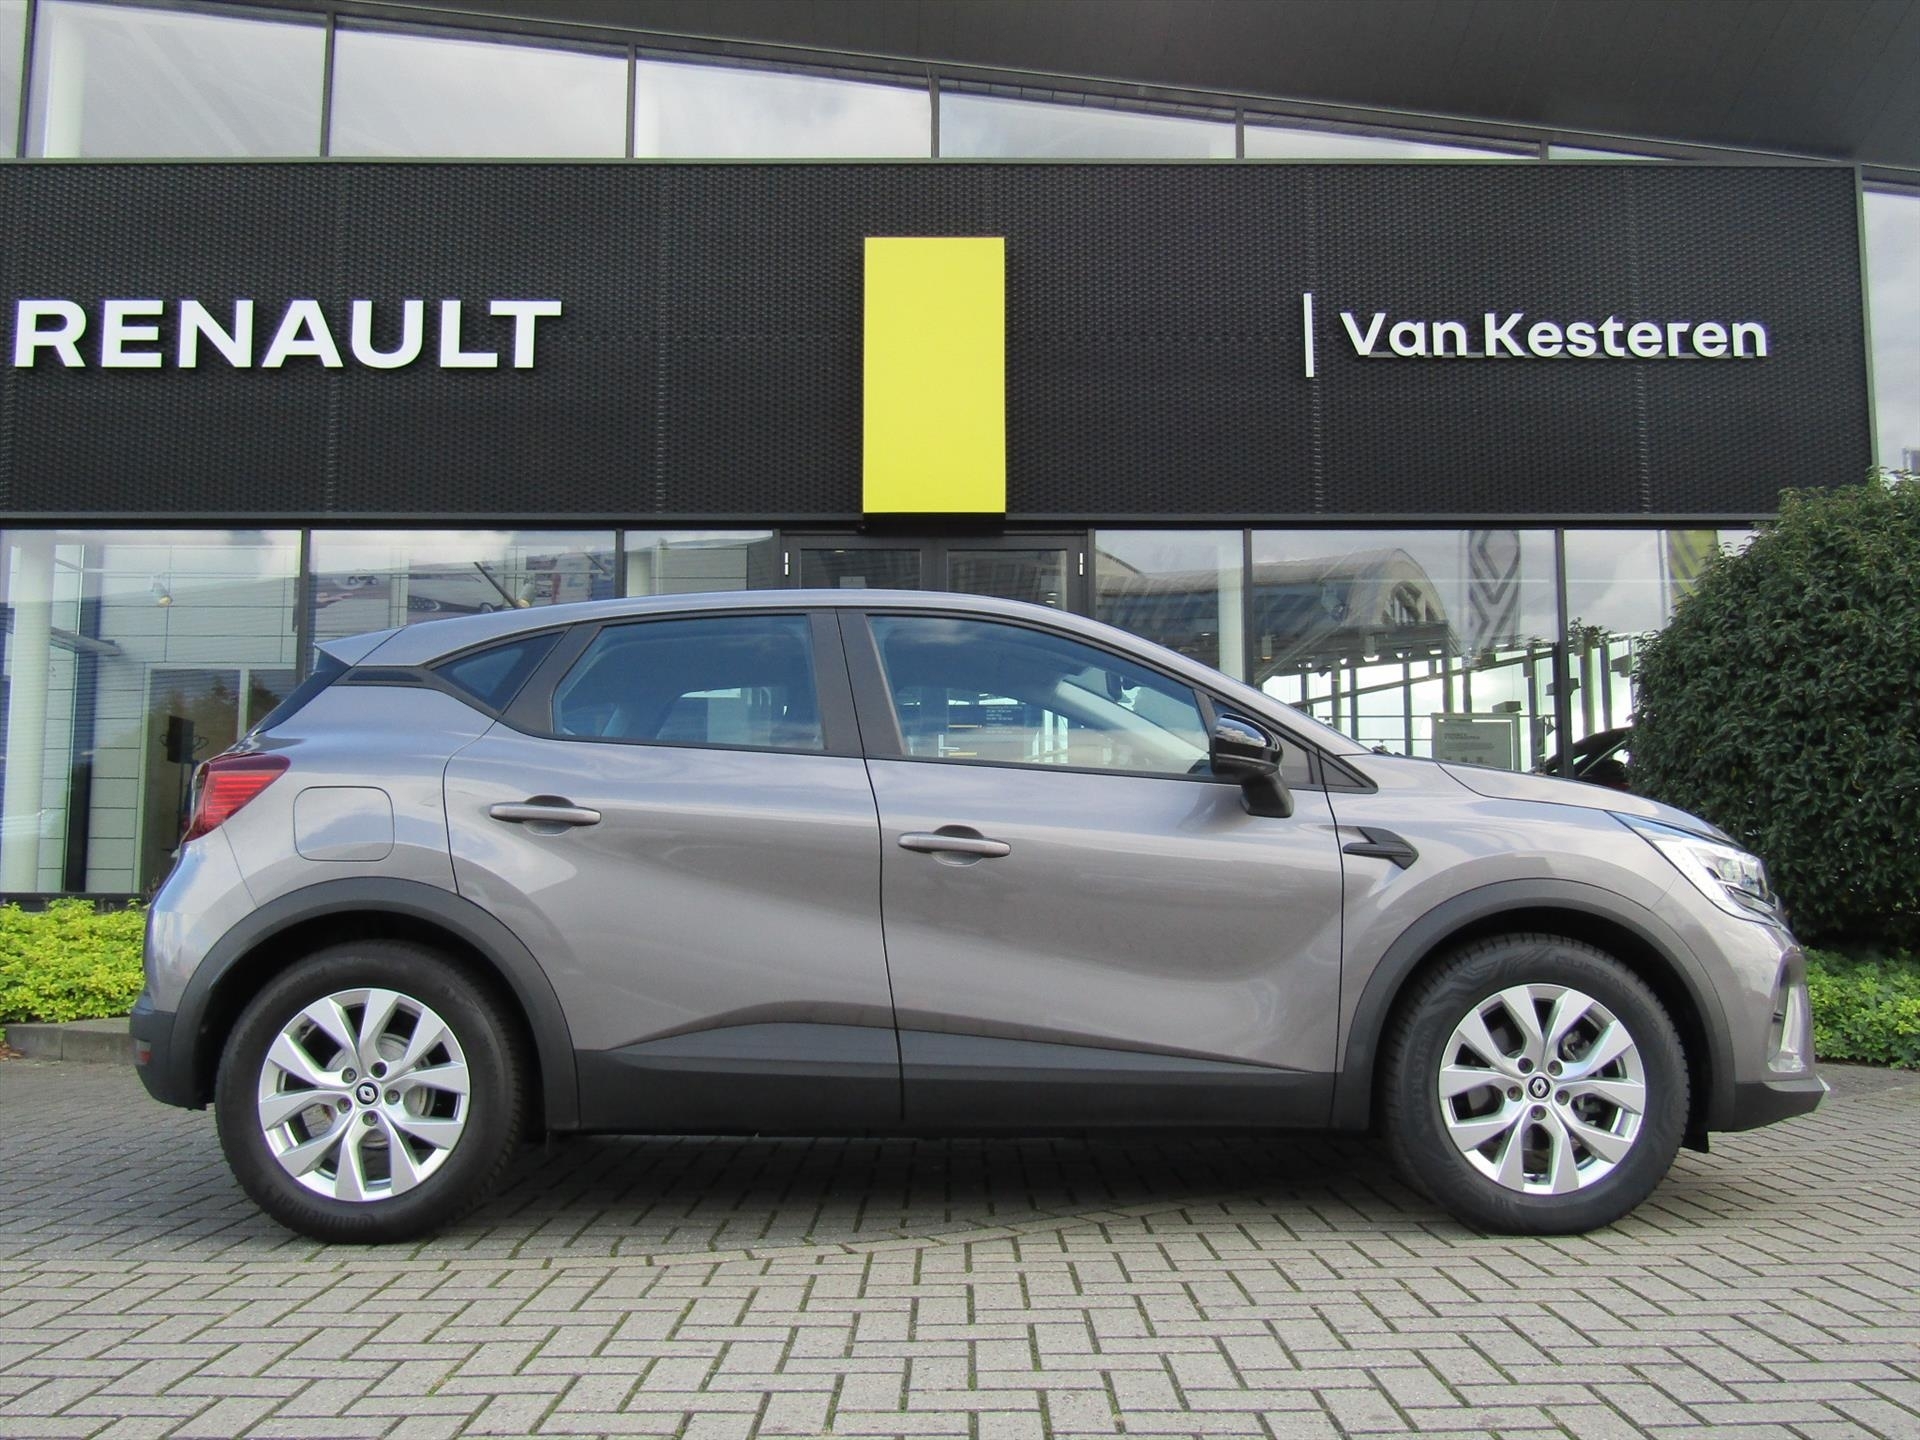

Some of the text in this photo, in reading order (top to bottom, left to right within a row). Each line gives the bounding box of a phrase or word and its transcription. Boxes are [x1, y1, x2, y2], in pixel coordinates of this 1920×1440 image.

[13, 299, 562, 369] RENAULT
[1340, 312, 1768, 358] Van Kesteren
